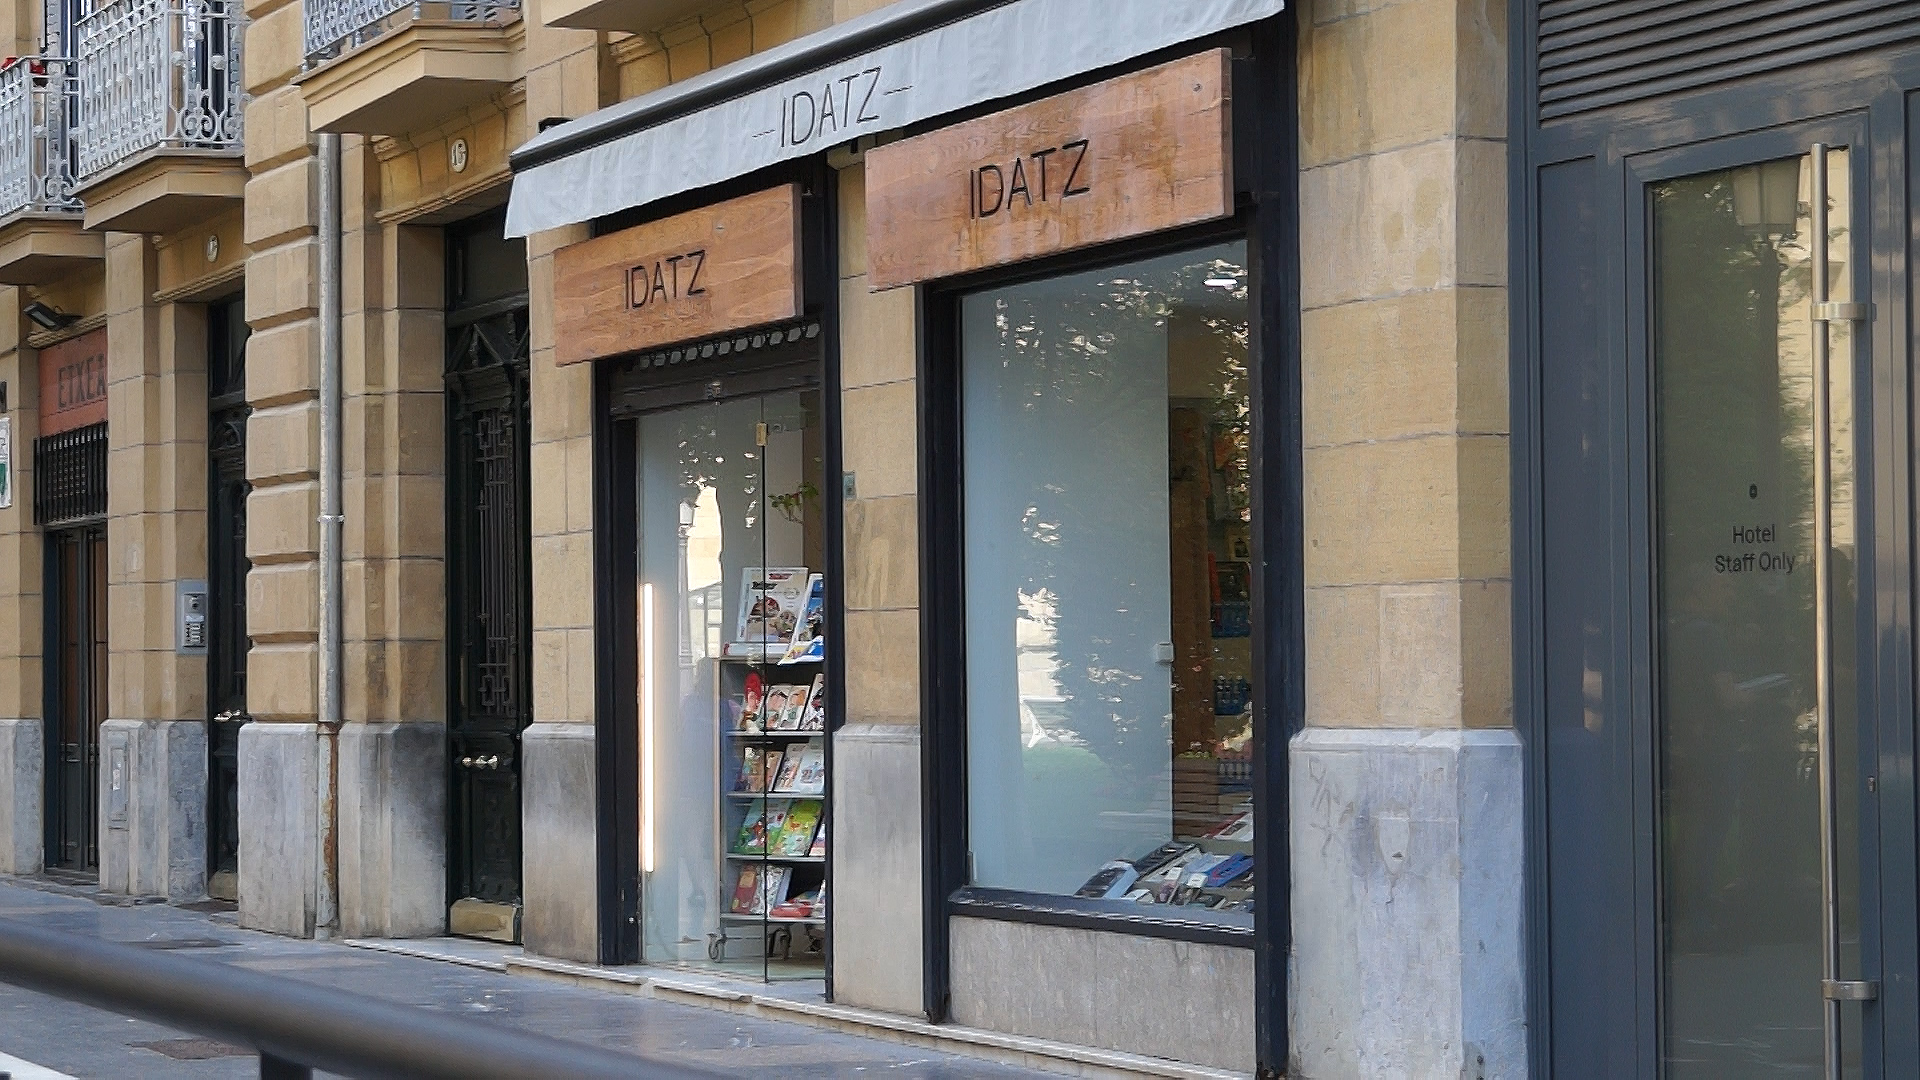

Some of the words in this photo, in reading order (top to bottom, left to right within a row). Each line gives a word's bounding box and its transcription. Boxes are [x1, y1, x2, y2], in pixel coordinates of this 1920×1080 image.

[970, 139, 1090, 219] IDATZ
[625, 249, 706, 309] IDATZ
[1732, 524, 1776, 543] Hotel
[1715, 553, 1756, 573] Staff
[1759, 552, 1796, 574] Only
